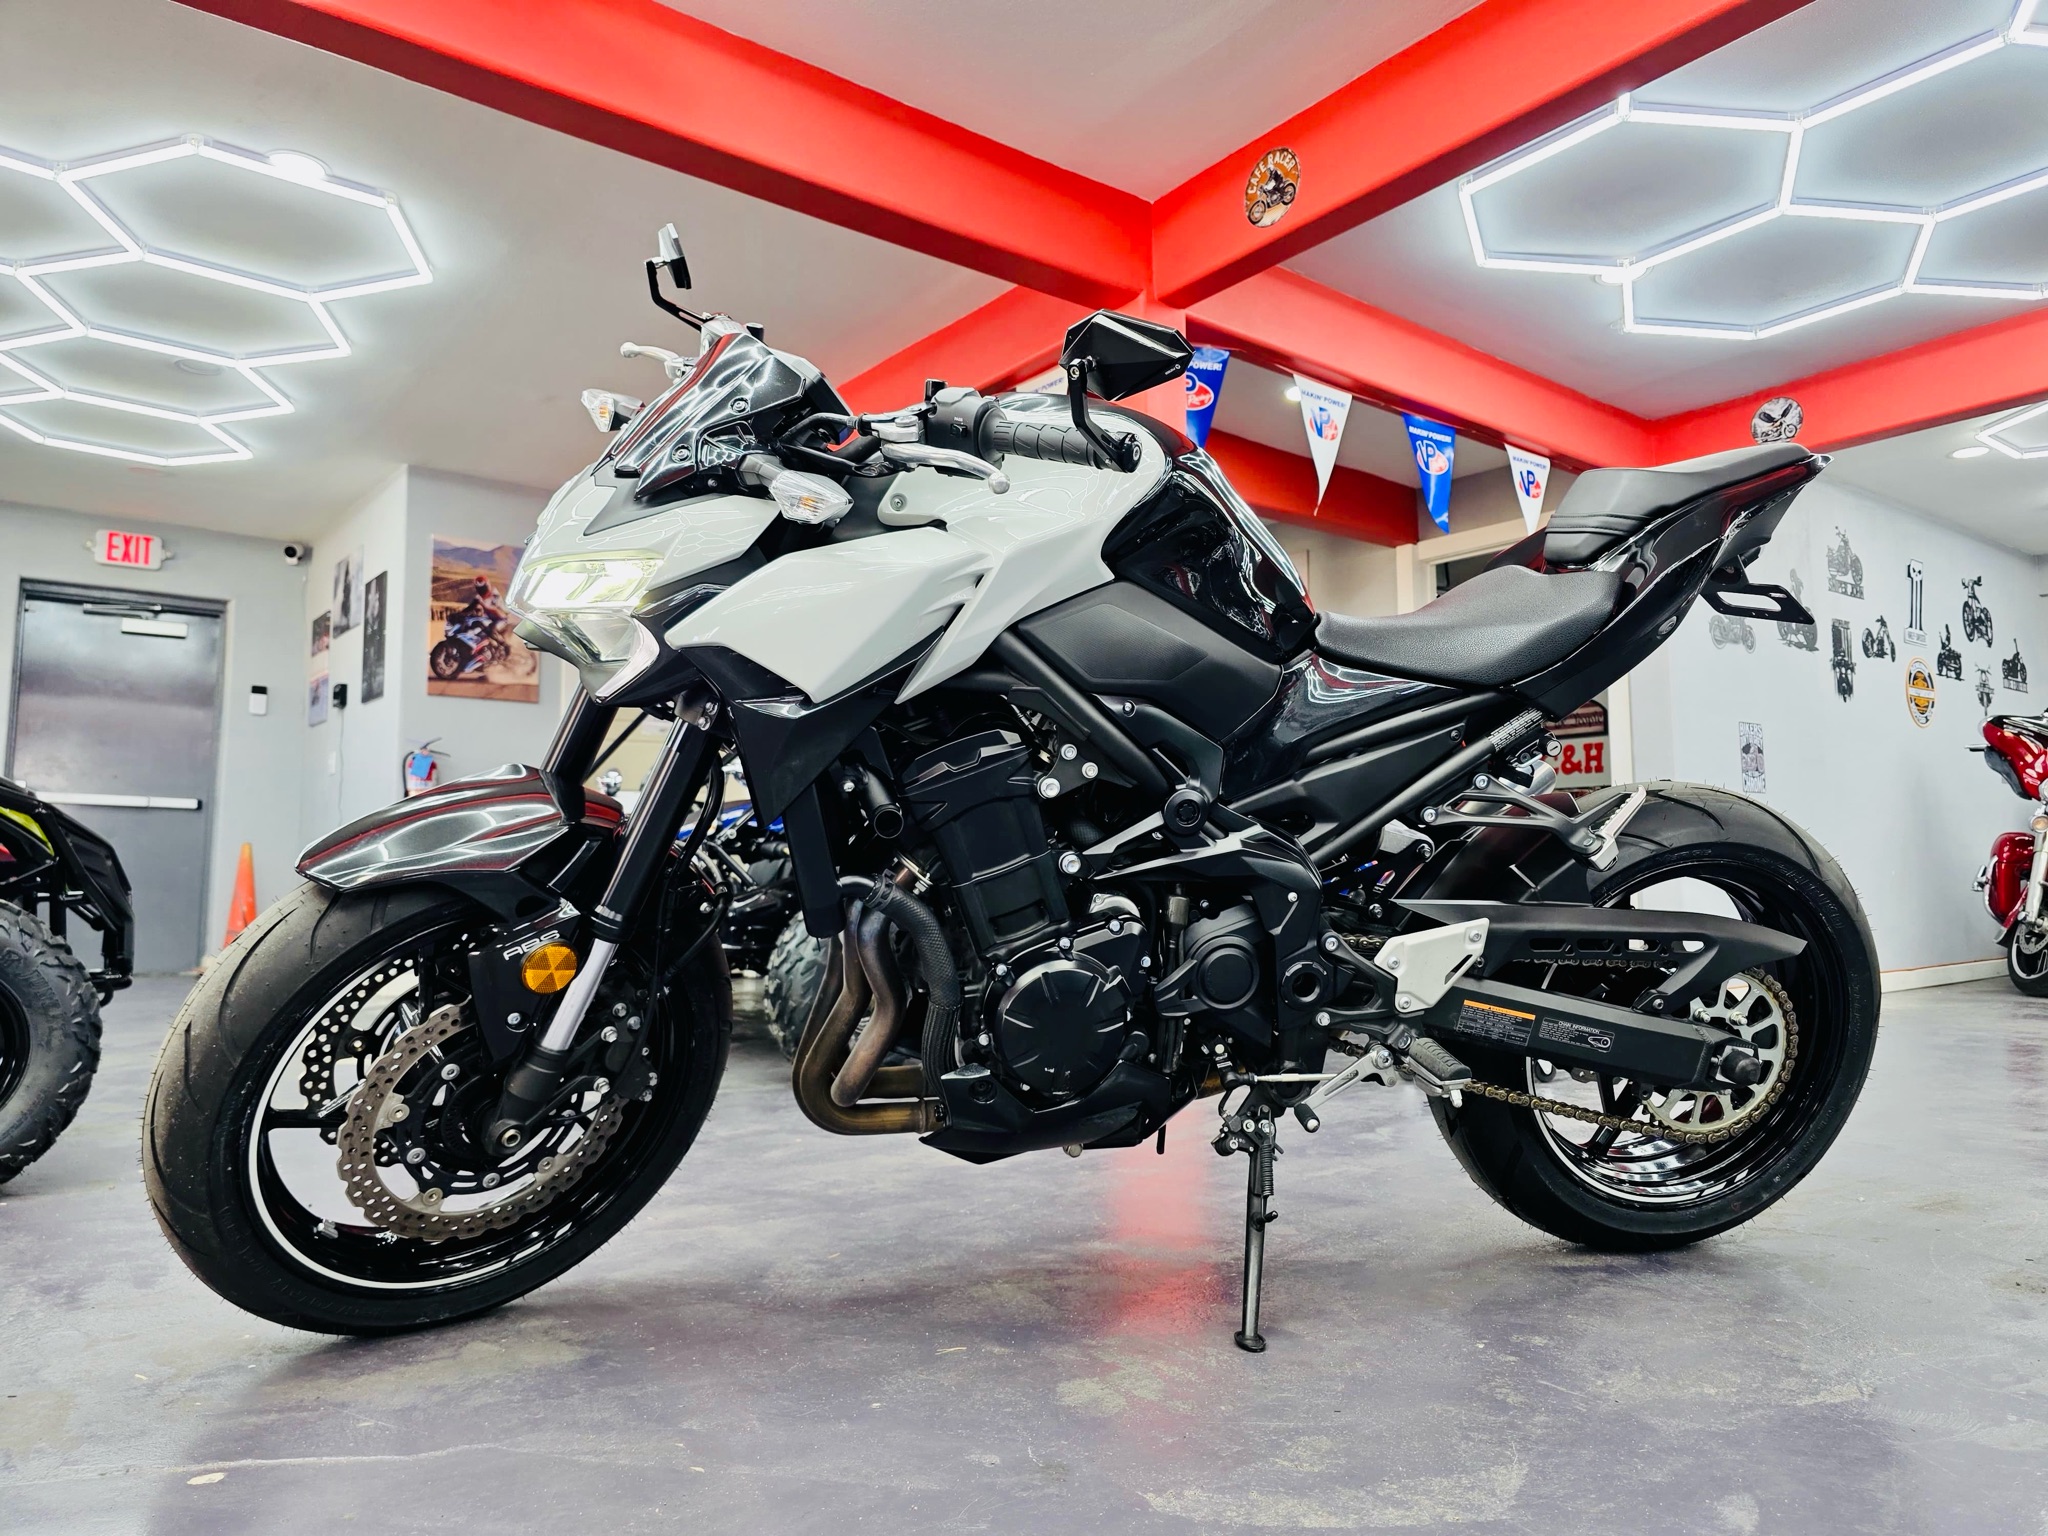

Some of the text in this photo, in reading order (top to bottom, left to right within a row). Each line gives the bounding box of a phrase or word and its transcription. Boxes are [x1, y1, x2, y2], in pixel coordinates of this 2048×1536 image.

[1247, 151, 1296, 194] CAFE RACER
[1519, 469, 1536, 498] VP
[106, 530, 154, 565] EXIT
[1739, 723, 1763, 739] BIKERS
[503, 929, 561, 961] ABS
[1572, 1023, 1601, 1034] INFORMATION
